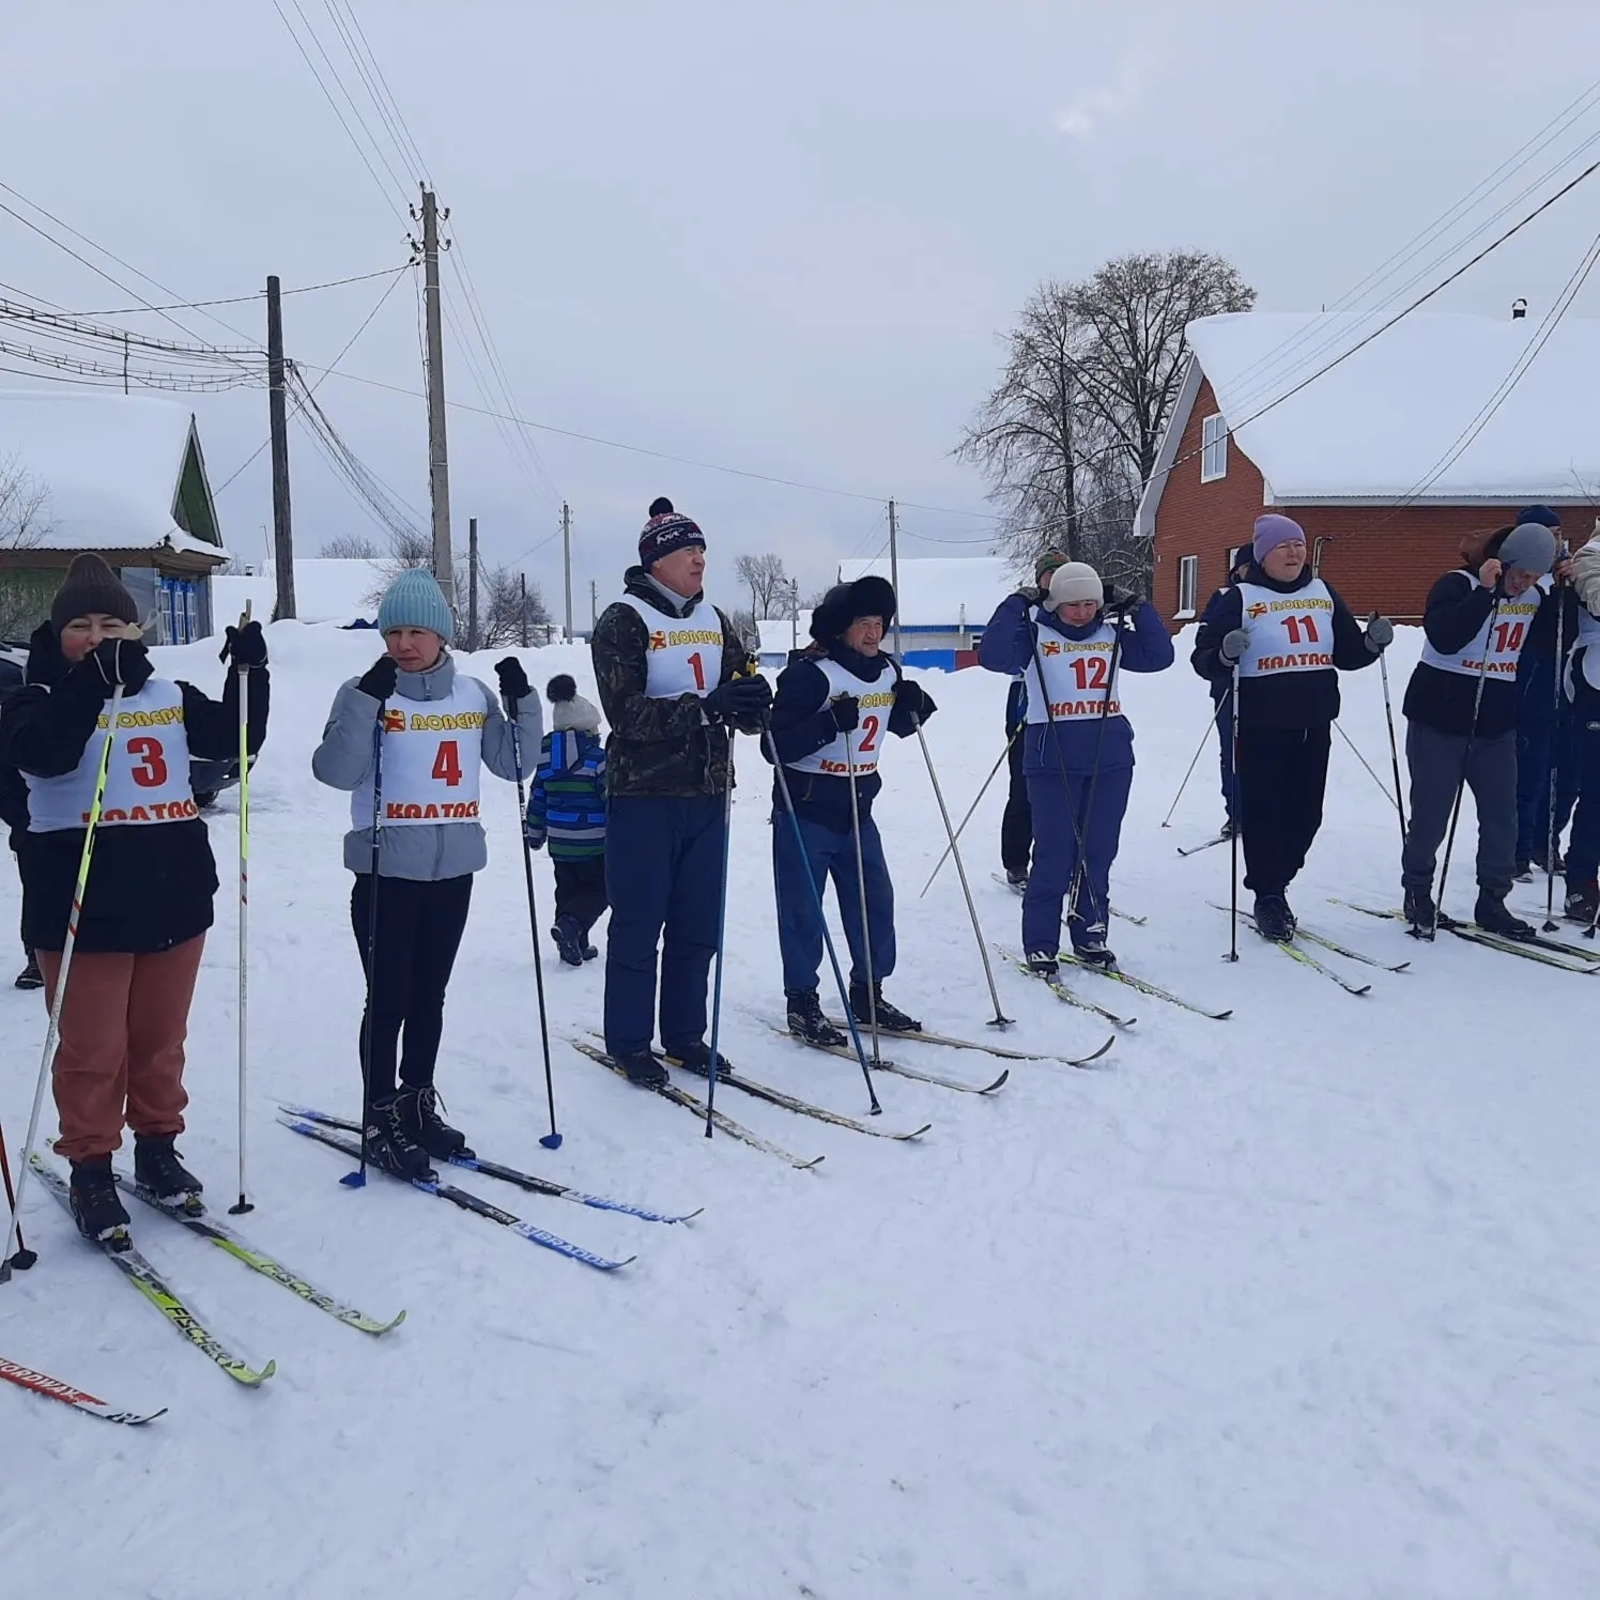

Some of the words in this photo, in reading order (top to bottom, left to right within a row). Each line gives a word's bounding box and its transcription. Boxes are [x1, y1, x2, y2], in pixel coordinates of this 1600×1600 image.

[1281, 615, 1319, 644] 11
[1494, 622, 1524, 653] 14
[687, 652, 705, 690] 1
[1069, 657, 1108, 689] 12
[858, 715, 879, 752] 2
[126, 737, 167, 787] 3
[431, 740, 462, 786] 4
